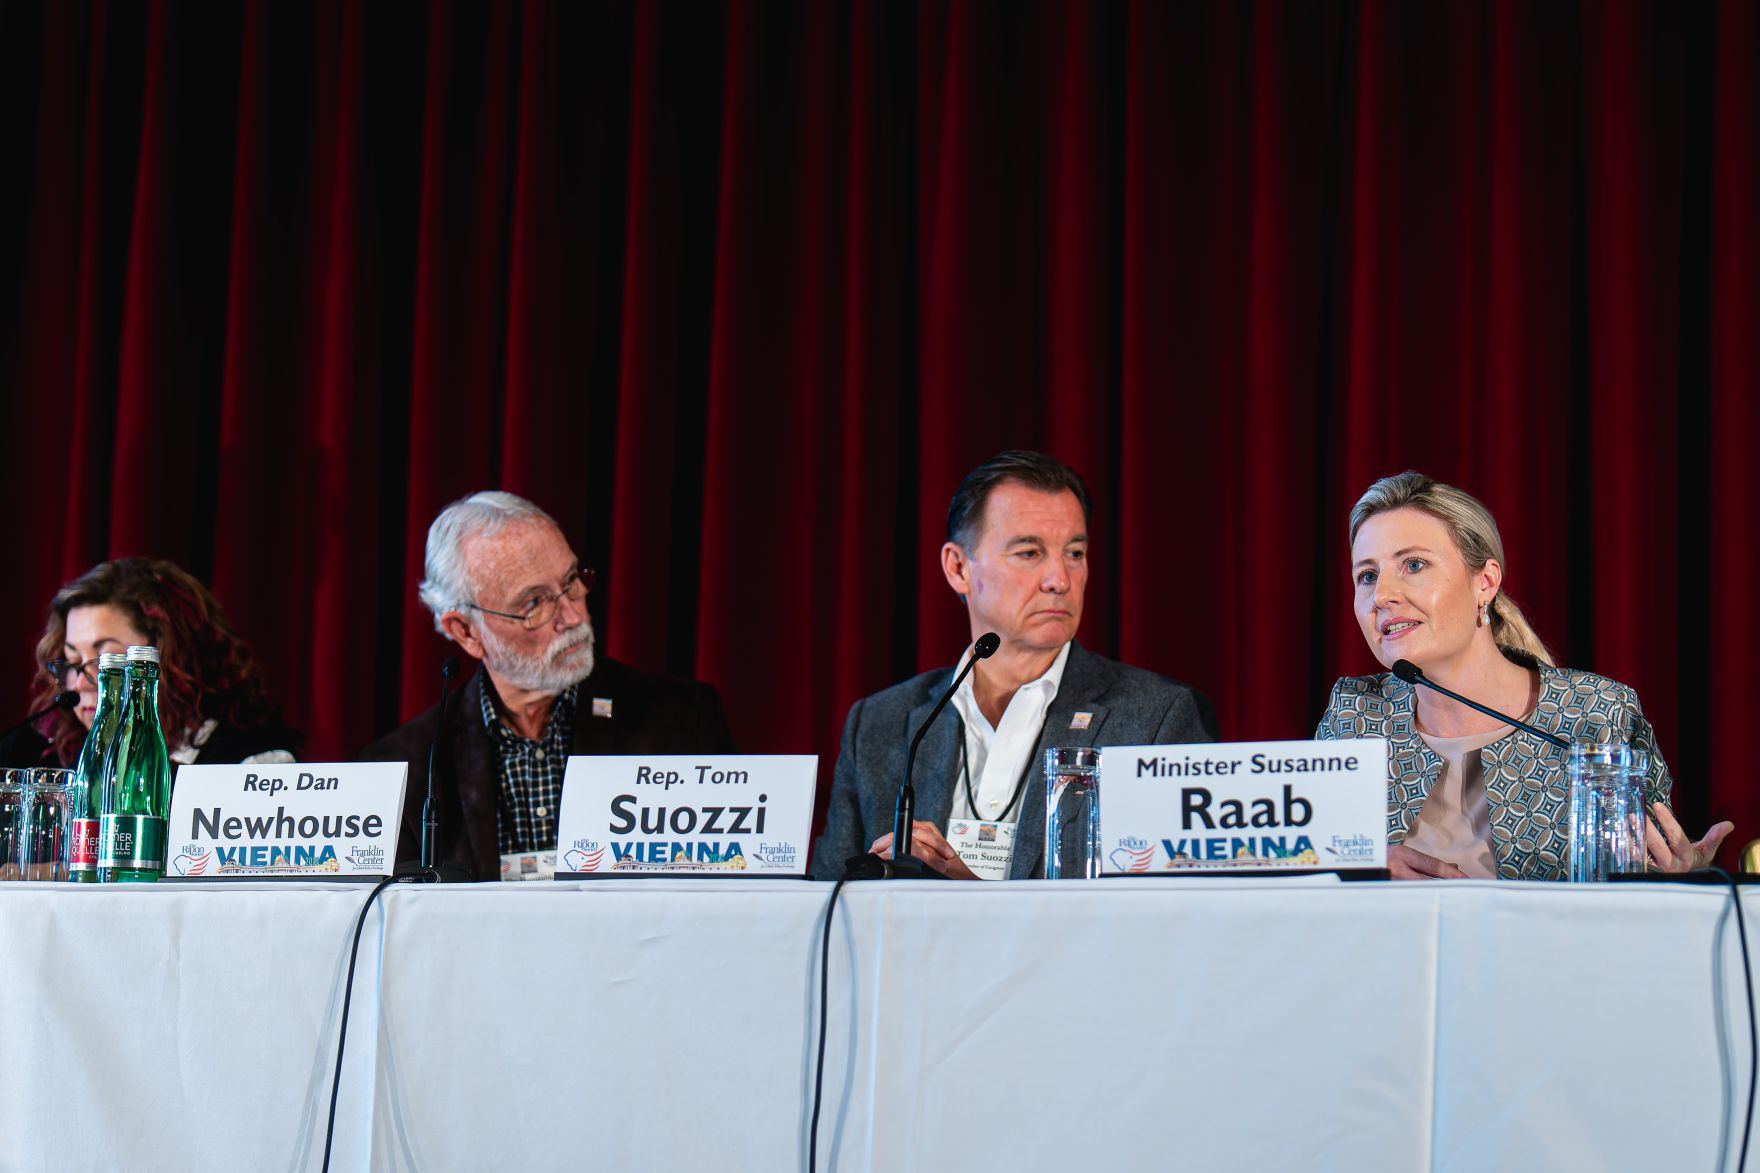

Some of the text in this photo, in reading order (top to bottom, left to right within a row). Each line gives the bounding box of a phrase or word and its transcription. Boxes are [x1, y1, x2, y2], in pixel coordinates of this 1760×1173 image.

[1136, 753, 1359, 778] Minister Susanne
[243, 772, 339, 796] Rep. Dan
[635, 765, 749, 790] Rep. Tom
[1180, 784, 1313, 830] Raab
[609, 793, 768, 836] Suozzi
[191, 806, 383, 840] Newhouse
[573, 840, 598, 850] Ripon
[975, 842, 1011, 851] Honorable
[1331, 834, 1374, 847] Franklin
[182, 845, 205, 855] Ripon
[351, 845, 384, 857] Franklin
[610, 841, 744, 863] VIENNA
[759, 842, 796, 854] Franklin
[1161, 835, 1316, 861] VIENNA
[1340, 846, 1374, 856] Center
[215, 845, 338, 867] VIENNA
[357, 855, 385, 865] Center
[766, 853, 796, 863] Center
[956, 851, 1012, 862] Tom Suozzi
